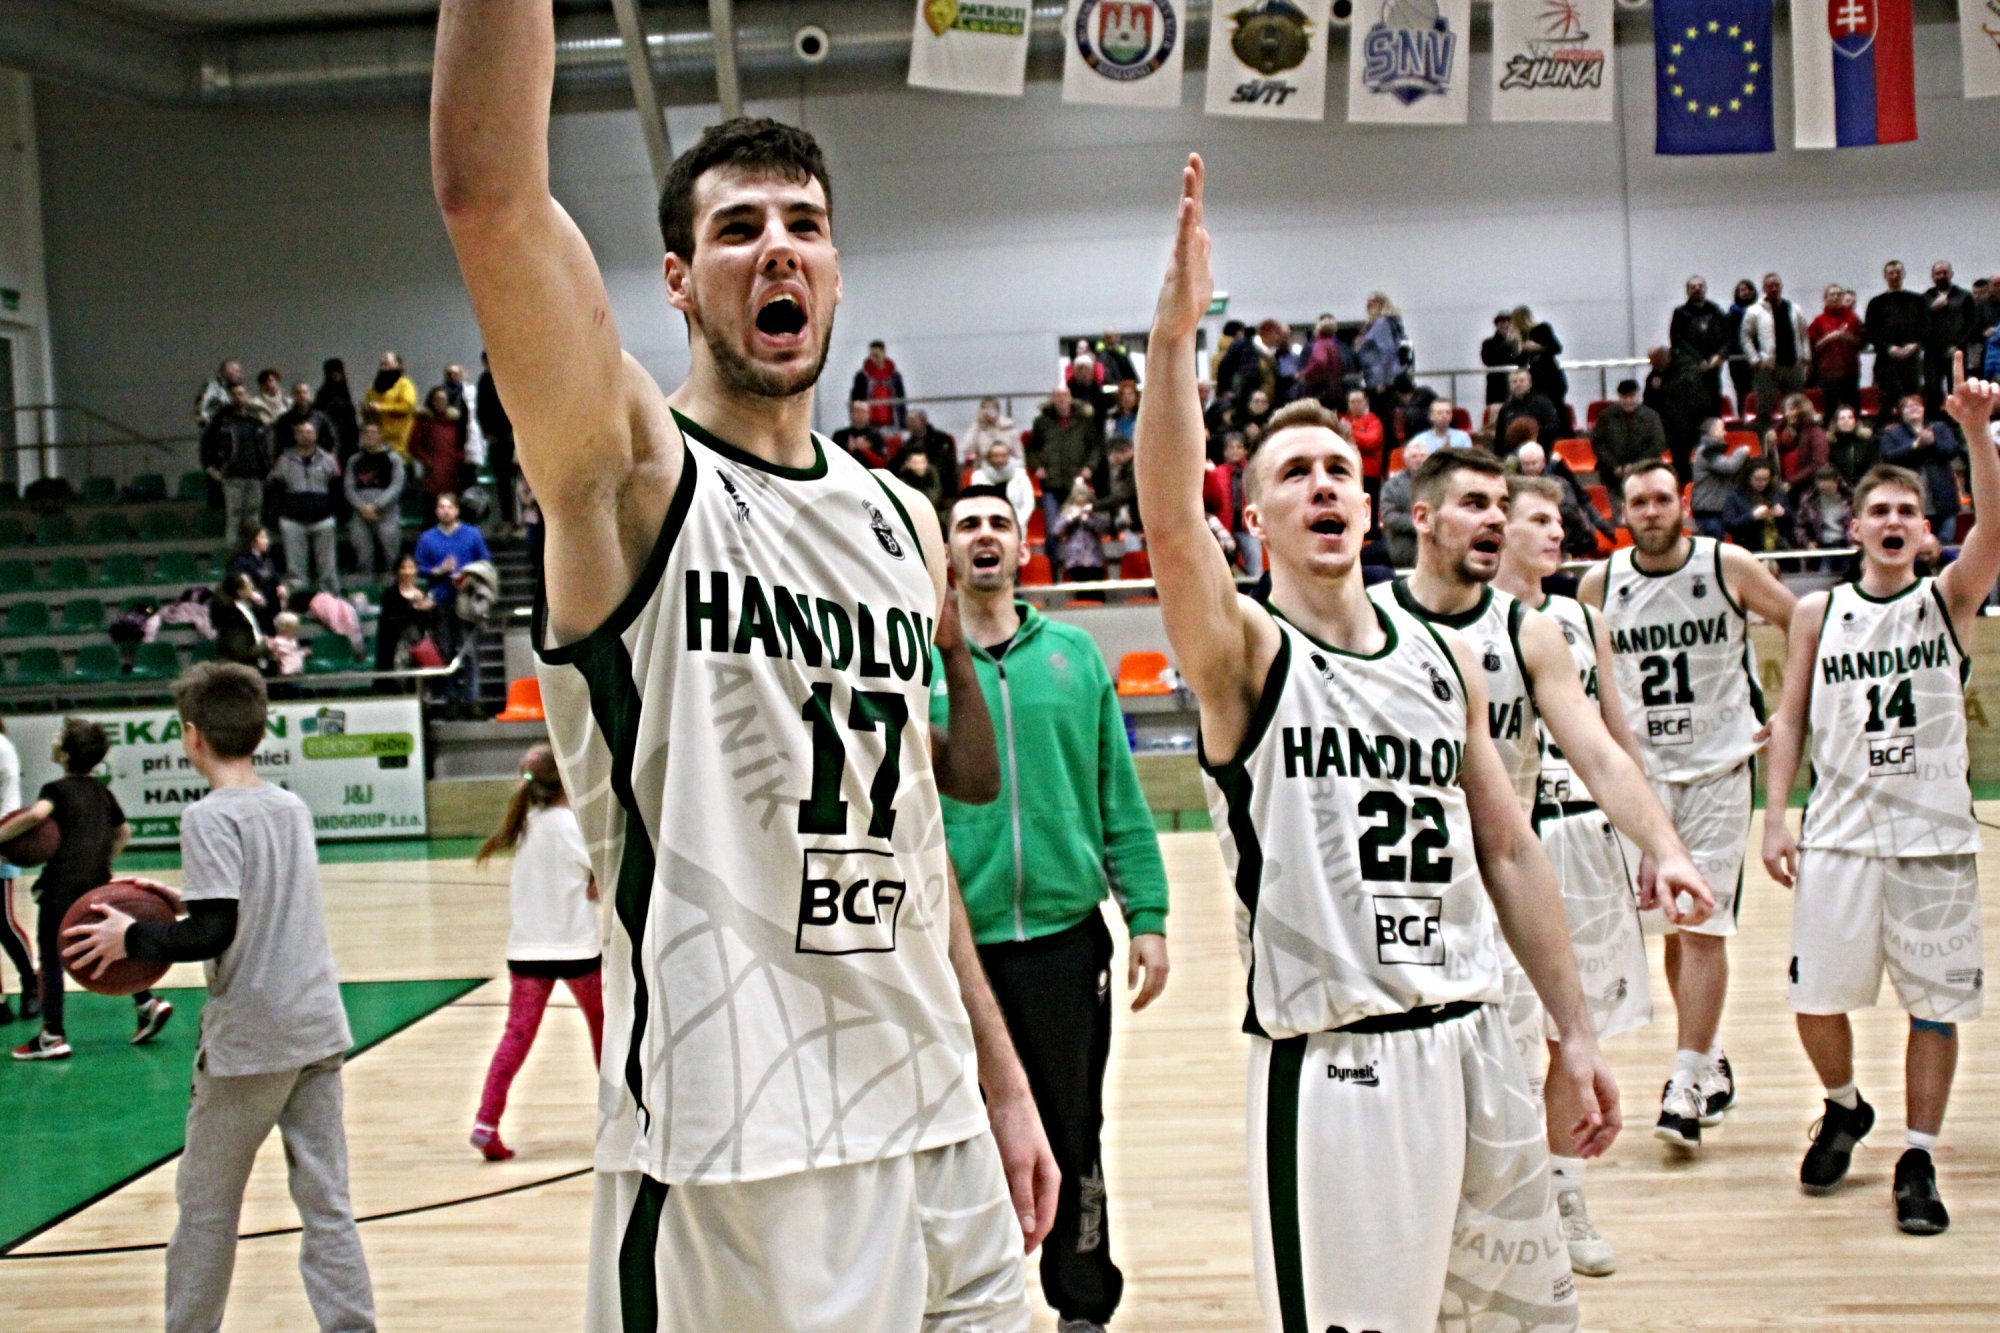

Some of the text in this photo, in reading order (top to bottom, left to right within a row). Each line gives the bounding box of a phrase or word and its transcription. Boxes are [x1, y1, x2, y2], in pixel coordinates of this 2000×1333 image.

[1364, 29, 1456, 84] SNV
[1500, 54, 1604, 90] ŽILINA
[1640, 652, 1695, 707] 21
[1822, 633, 1951, 685] HANDLOVÁ
[1865, 678, 1917, 733] 14
[1648, 719, 1690, 736] BCF
[142, 755, 170, 774] pri
[798, 681, 909, 842] 17
[1870, 745, 1915, 767] BCF
[343, 783, 374, 806] J&J
[1358, 791, 1454, 884] 22
[800, 876, 905, 926] BCF
[1376, 915, 1441, 947] BCF
[1327, 1064, 1376, 1082] Dynasit
